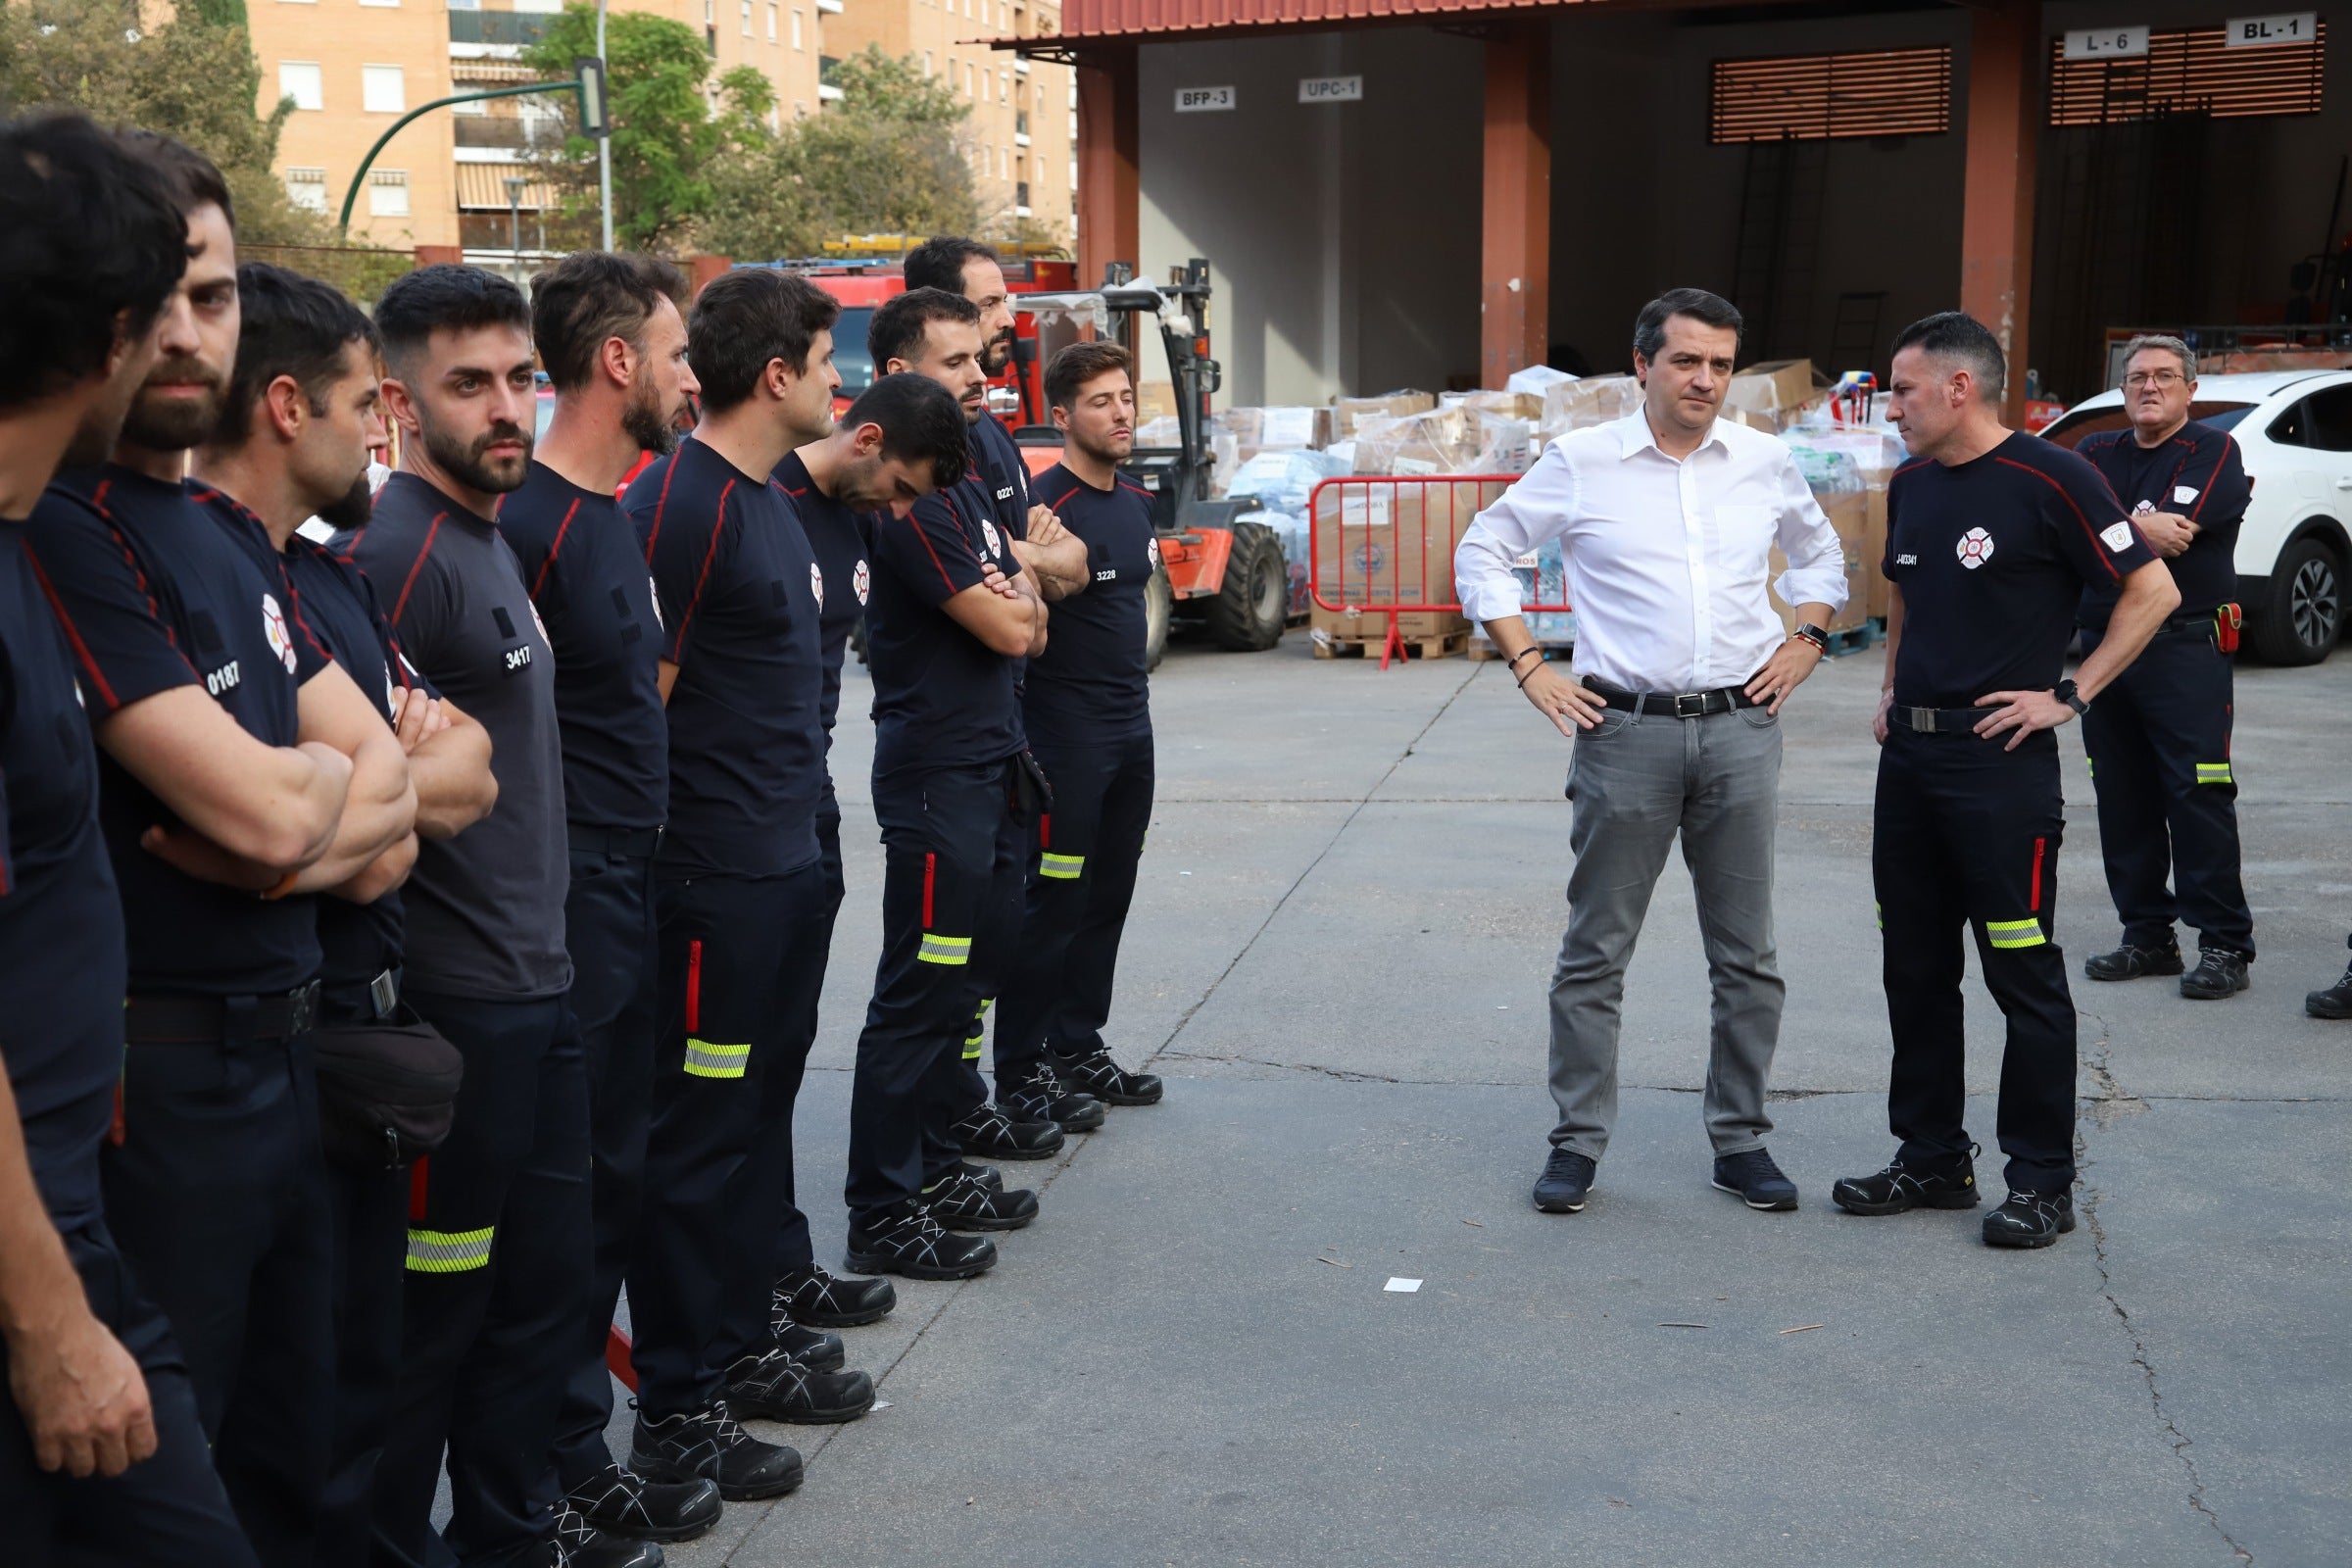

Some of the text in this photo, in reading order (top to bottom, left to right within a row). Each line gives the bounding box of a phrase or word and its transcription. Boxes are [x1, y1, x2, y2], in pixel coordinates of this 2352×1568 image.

[2243, 23, 2272, 39] BL
[2288, 19, 2298, 35] 1
[2086, 35, 2098, 50] L
[2117, 33, 2128, 49] 6
[997, 486, 1013, 500] 0221
[1097, 569, 1116, 581] 3228
[506, 645, 530, 669] 3417
[207, 660, 240, 695] 0187
